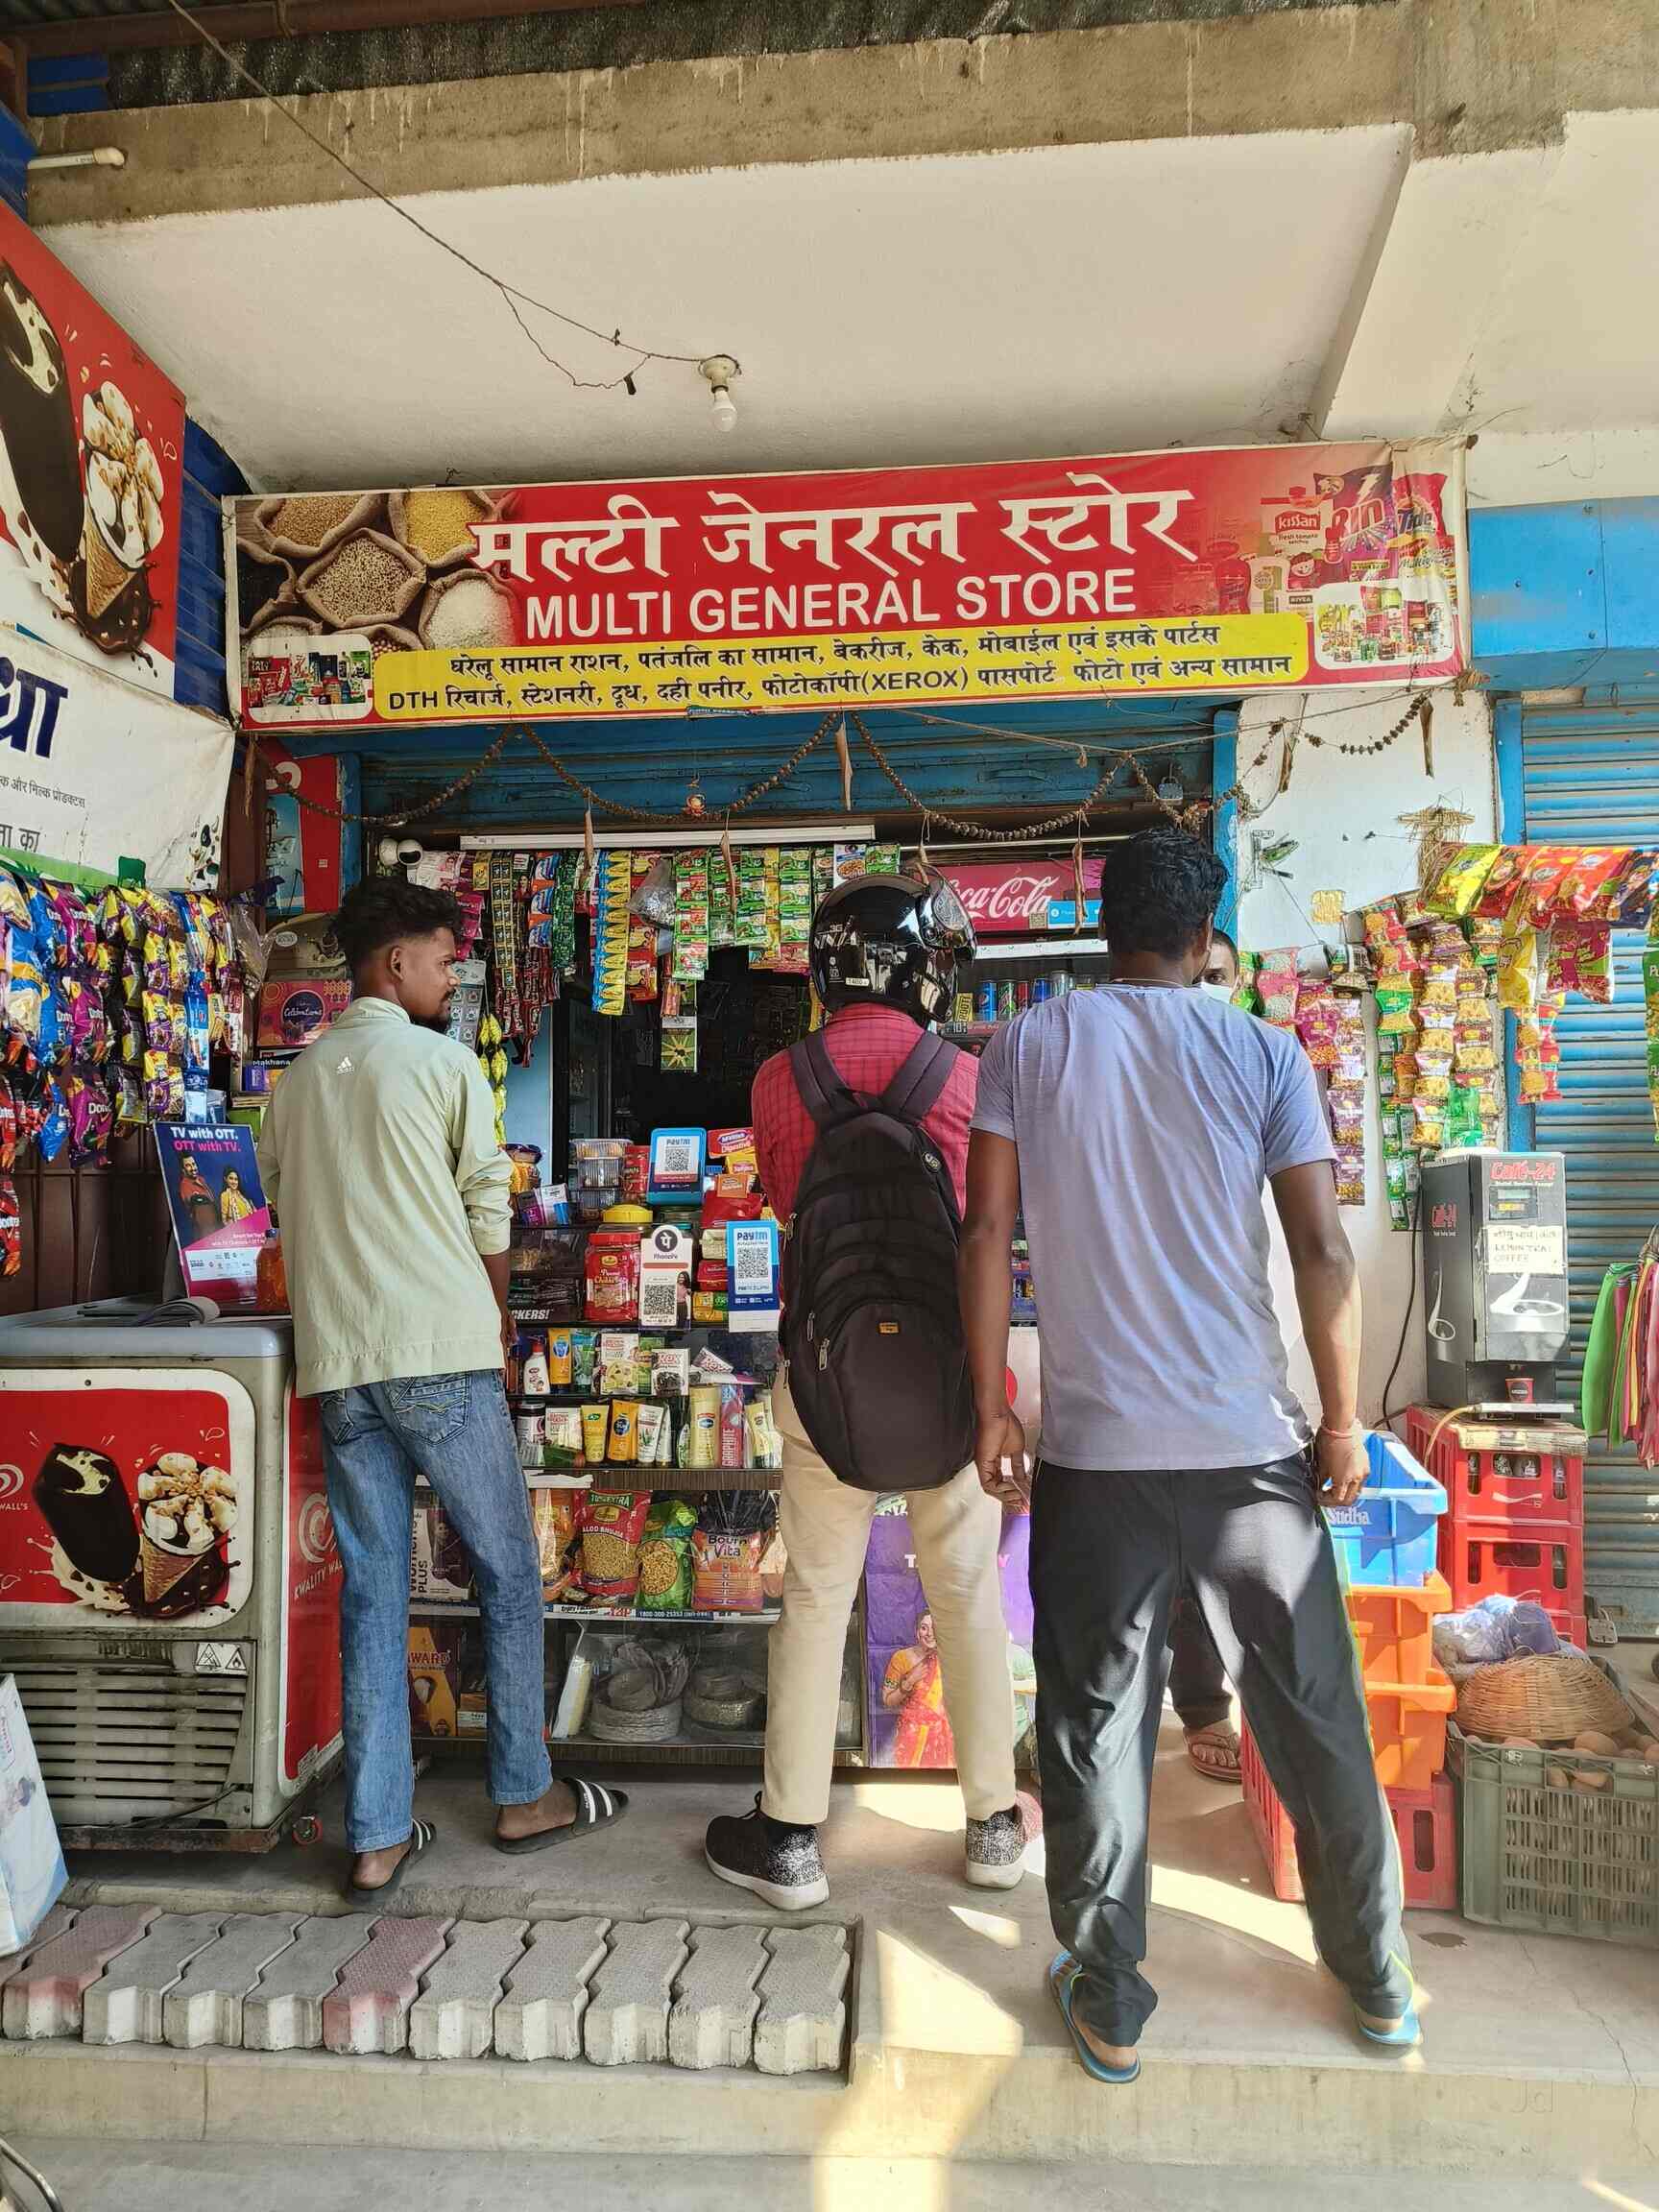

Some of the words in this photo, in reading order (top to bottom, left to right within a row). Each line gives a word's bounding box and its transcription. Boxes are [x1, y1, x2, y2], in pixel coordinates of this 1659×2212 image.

[468, 494, 680, 583] मल्टी
[701, 491, 978, 578] जेनरल
[998, 471, 1199, 565] स्टोर
[527, 590, 671, 639] MULTI
[689, 578, 940, 634] GENERAL
[956, 568, 1137, 621] STORE
[450, 654, 494, 681] घरेलू
[500, 655, 564, 674] सामान
[569, 653, 630, 674] राशन,
[638, 644, 712, 669] पतंजलि
[718, 648, 744, 667] का
[752, 645, 824, 666] सामान,
[832, 636, 912, 661] बेकरीज,
[923, 634, 969, 659] केक,
[977, 628, 1061, 656] मोबाईल
[1067, 625, 1099, 655] एवं
[1105, 623, 1158, 651] इसके
[1164, 620, 1221, 647] पार्टस
[389, 690, 438, 710] DTH
[445, 683, 513, 710] रिचार्ज,
[521, 681, 603, 708] स्टेशनरी,
[612, 683, 649, 709] दूध,
[658, 677, 692, 701] दही
[697, 675, 753, 702] पनीर,
[977, 660, 1057, 687] पासपोर्ट
[1073, 658, 1124, 683] फोटो
[1130, 656, 1163, 685] एवं
[1170, 659, 1215, 678] अन्य
[1221, 656, 1292, 676] सामान
[18, 828, 40, 853] का
[949, 876, 1060, 919] ca-Cola
[171, 1127, 185, 1138] TV
[188, 1127, 214, 1139] with
[215, 1129, 239, 1140] OTT.
[174, 1141, 195, 1152] OTT
[198, 1141, 223, 1152] with
[223, 1142, 242, 1152] TV.
[512, 1309, 550, 1320] CKERS!
[722, 1428, 734, 1467] GRAPHITE
[709, 1535, 747, 1545] Bourn
[714, 1544, 740, 1557] Vita
[419, 1560, 427, 1593] PLUS
[407, 1651, 450, 1664] WARD
